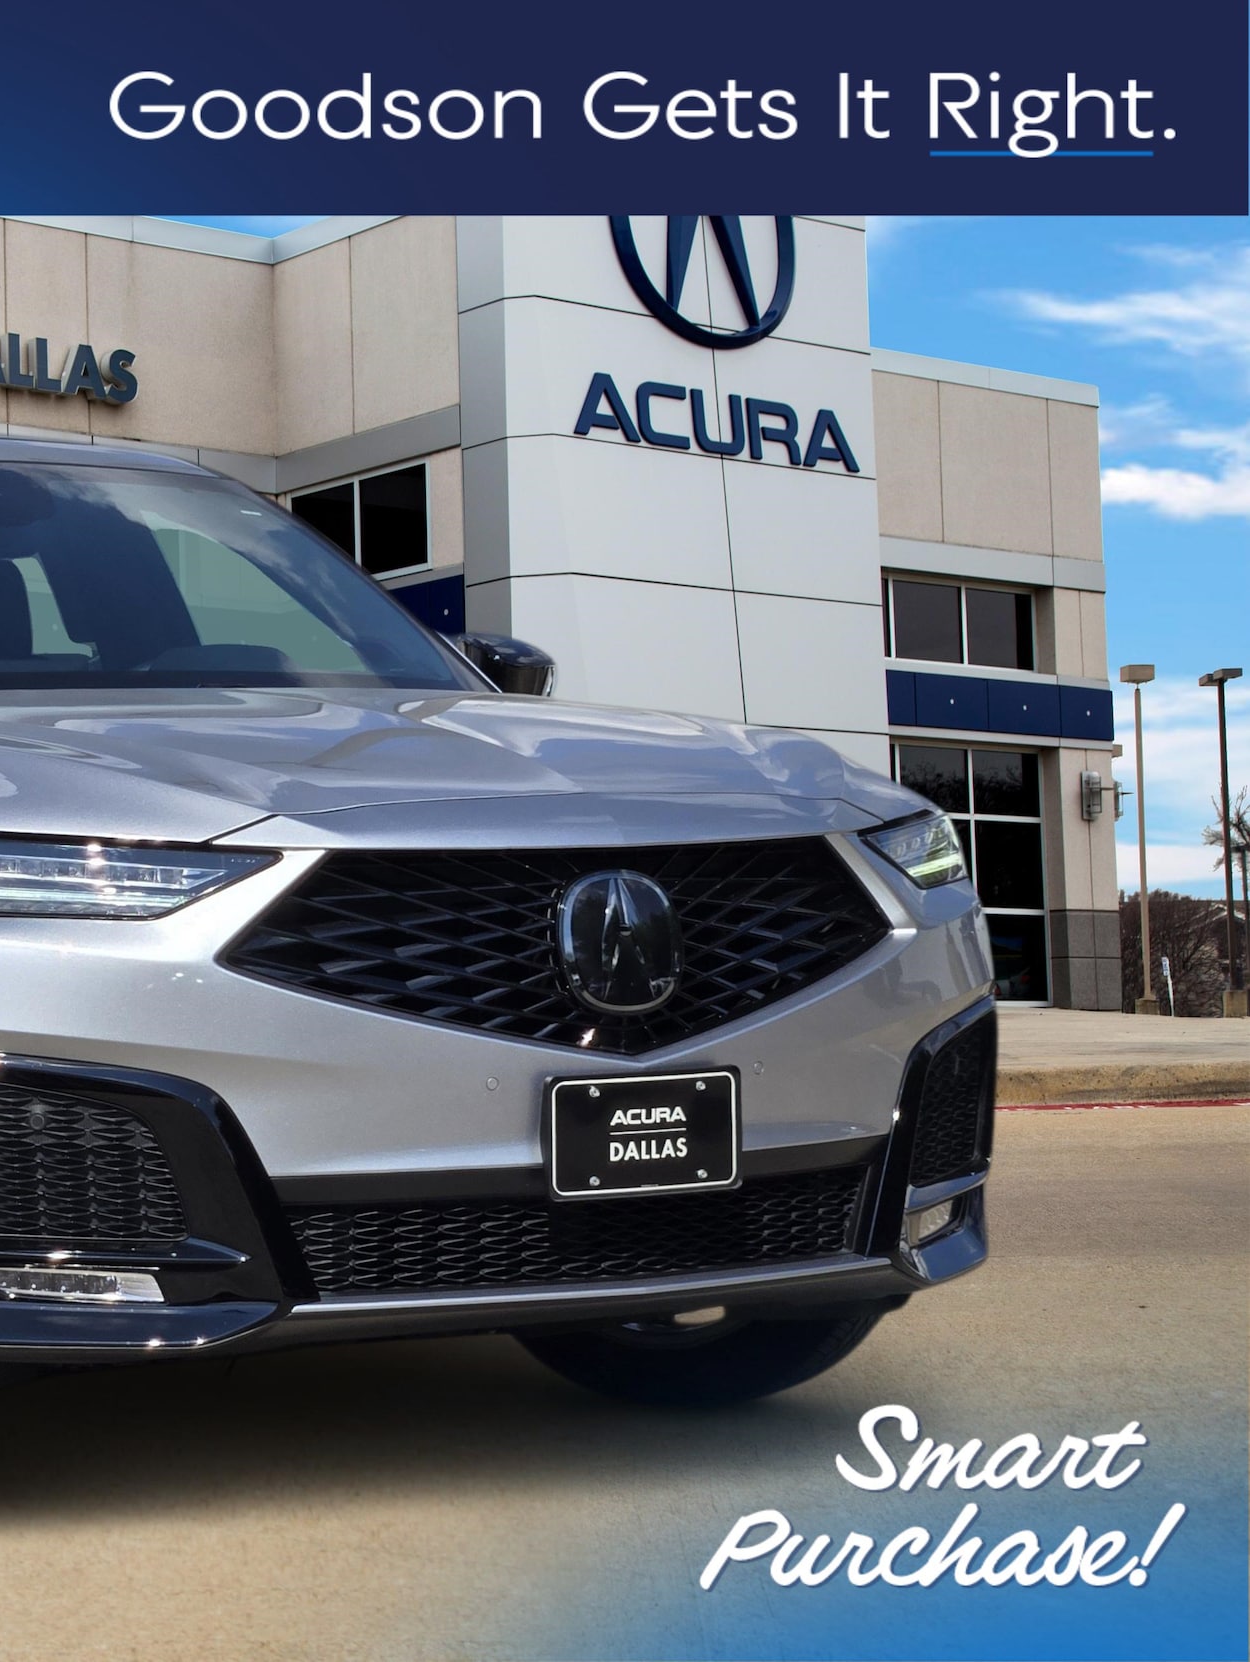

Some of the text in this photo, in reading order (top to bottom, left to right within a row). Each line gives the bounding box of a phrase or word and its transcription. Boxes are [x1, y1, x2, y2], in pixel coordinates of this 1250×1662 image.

[573, 373, 860, 472] ACURA
[610, 1106, 687, 1126] ACURA
[609, 1137, 688, 1162] DALLAS
